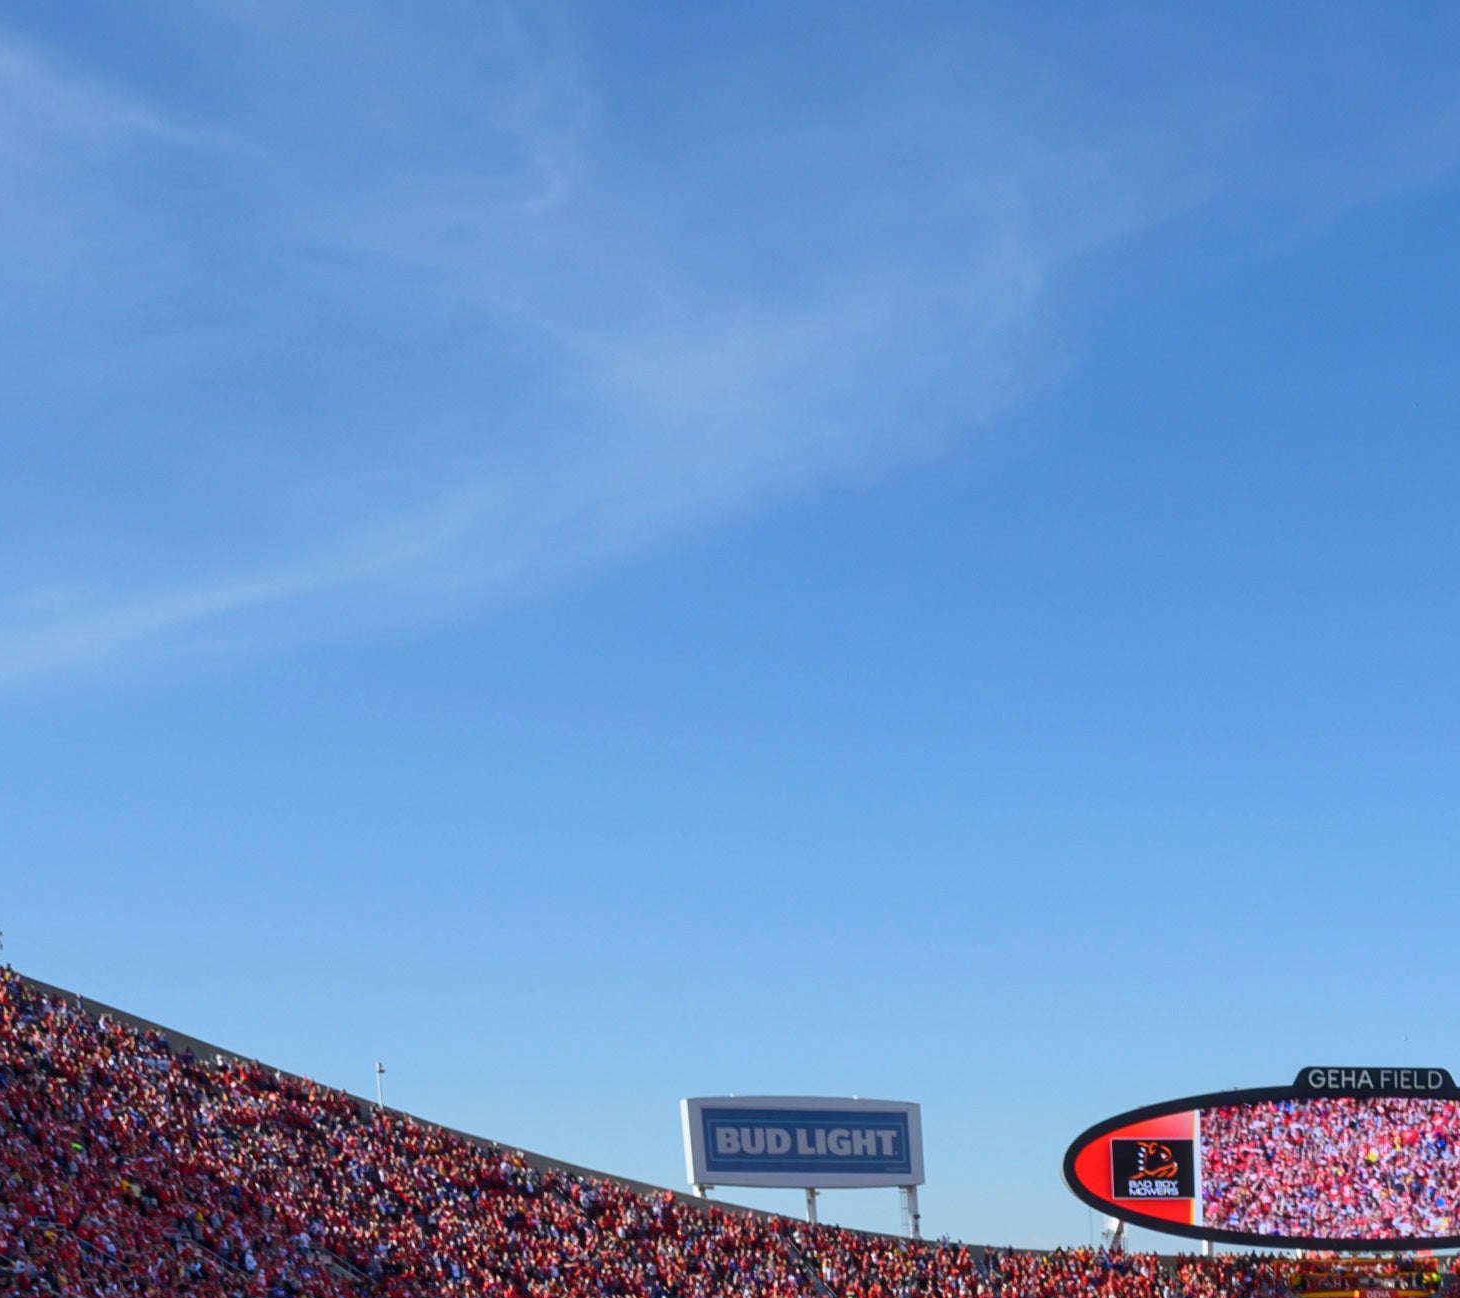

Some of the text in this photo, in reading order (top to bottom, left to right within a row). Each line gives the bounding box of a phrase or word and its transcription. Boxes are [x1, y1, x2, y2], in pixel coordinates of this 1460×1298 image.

[1308, 1068, 1443, 1090] GEHA FIELD
[715, 1126, 897, 1156] BUD LIGHT
[1128, 1179, 1178, 1189] BAD BOY
[1128, 1187, 1180, 1196] MOWERS
[1366, 1290, 1391, 1298] GEHA
